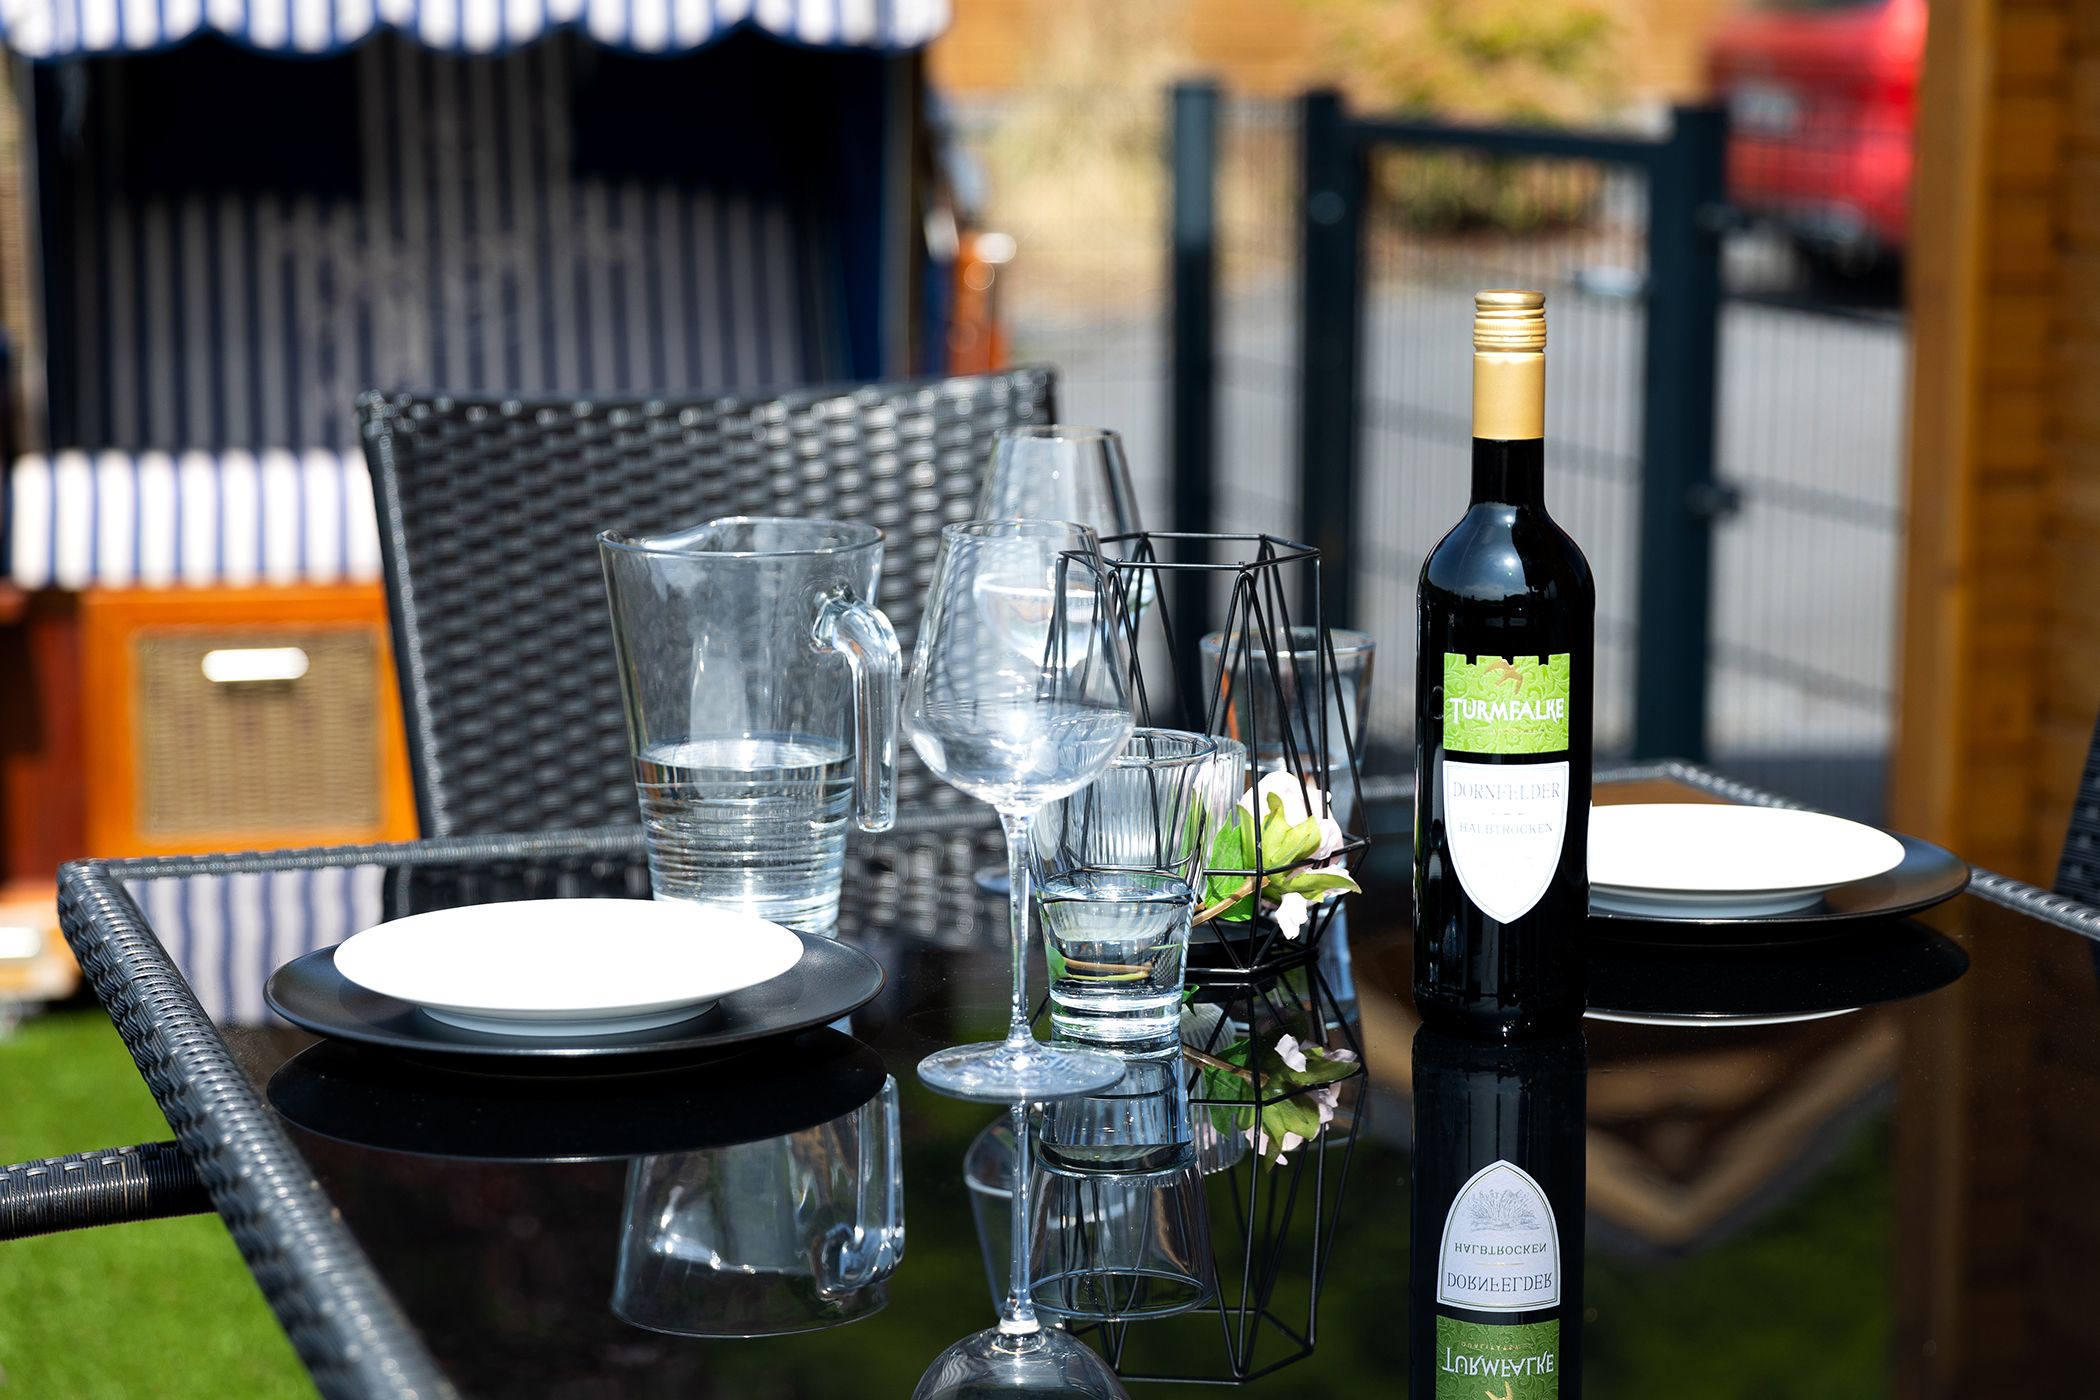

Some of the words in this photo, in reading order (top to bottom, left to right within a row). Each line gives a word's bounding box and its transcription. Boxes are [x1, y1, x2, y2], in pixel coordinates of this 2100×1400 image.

[1450, 698, 1564, 723] TURMFALKE
[1453, 781, 1560, 800] DORNFELDER
[1459, 822, 1553, 834] HALBTROCKEN
